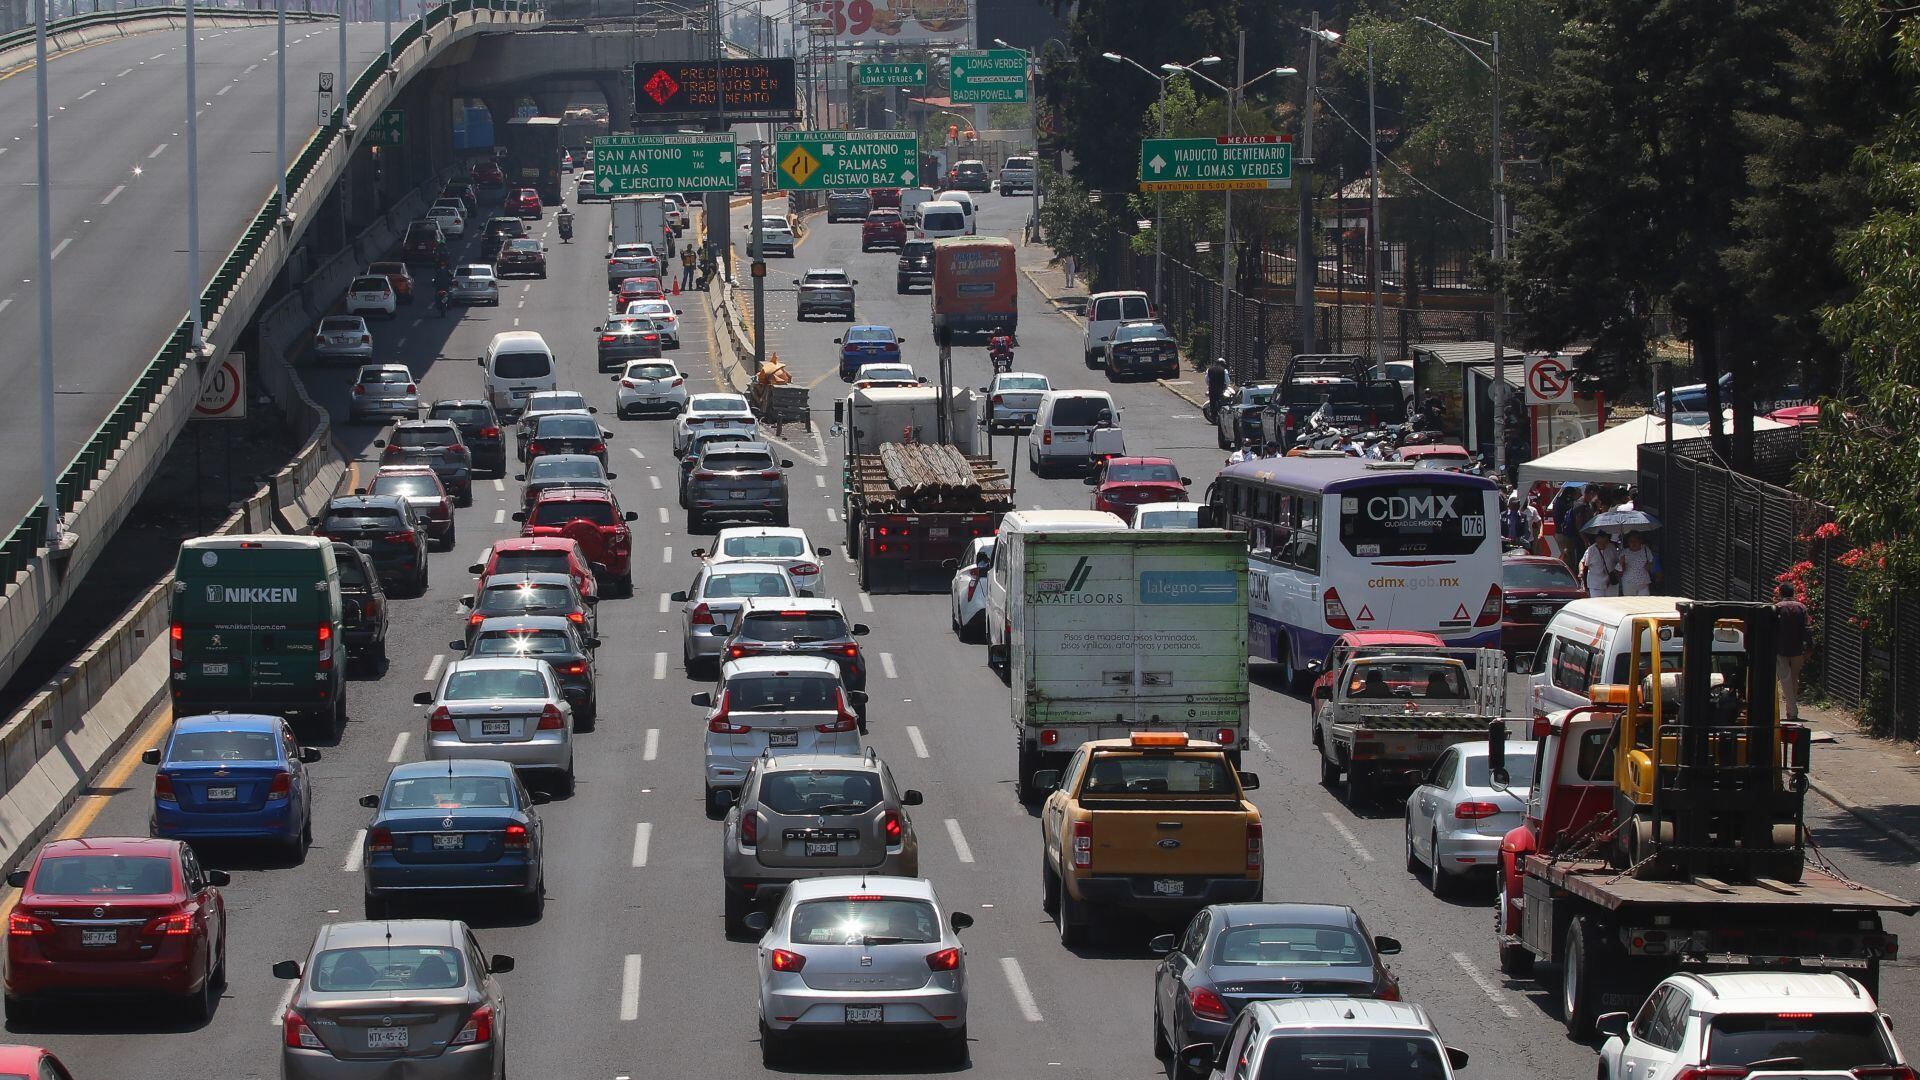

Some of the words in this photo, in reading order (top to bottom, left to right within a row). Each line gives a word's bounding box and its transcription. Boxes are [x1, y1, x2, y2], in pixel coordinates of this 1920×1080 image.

[967, 59, 993, 69] LOMAS
[995, 58, 1023, 69] VERDES
[866, 66, 909, 74] SALIDA
[861, 76, 884, 84] LOMAS
[887, 75, 913, 83] VERDES
[689, 92, 770, 103] PAVMENTO
[953, 90, 979, 100] BADEN
[981, 89, 1012, 100] POWELL
[638, 136, 663, 144] CAMACHO
[696, 135, 731, 143] BICENTENARIO
[820, 131, 845, 140] CAMACHO
[877, 131, 913, 139] BICENTENARIO
[1227, 136, 1266, 144] MEXICO
[598, 150, 624, 161] SAN
[629, 149, 682, 160] ANTONIO
[839, 145, 849, 156] S.
[850, 144, 898, 155] ANTONIO
[1174, 149, 1218, 161] VIADUCTO
[1223, 147, 1285, 160] BICENTENARIO
[598, 163, 648, 175] PALMAS
[838, 159, 887, 170] PALMAS
[1175, 165, 1190, 177] AV.
[1197, 164, 1234, 177] LOMAS
[1241, 163, 1283, 176] VERDES
[620, 177, 673, 189] EJERCITO
[677, 176, 734, 188] NACIONAL
[822, 173, 869, 184] GUSTAVO
[872, 173, 895, 184] BAZ
[1367, 495, 1458, 520] CDMX
[1463, 517, 1483, 534] 076
[1147, 580, 1197, 597] lalegno
[1249, 571, 1270, 602] CDMX
[1368, 576, 1460, 590] cdmx.gob.mx
[225, 588, 297, 602] NIKKEN
[1026, 593, 1123, 604] ZAYATFLOORS
[1064, 633, 1081, 641] Pisos
[1084, 633, 1094, 641] de
[1134, 633, 1153, 642] pisos
[1061, 642, 1080, 651] pisos
[847, 1010, 882, 1019] PBJ-87-73
[369, 1032, 407, 1042] NTX-45-23
